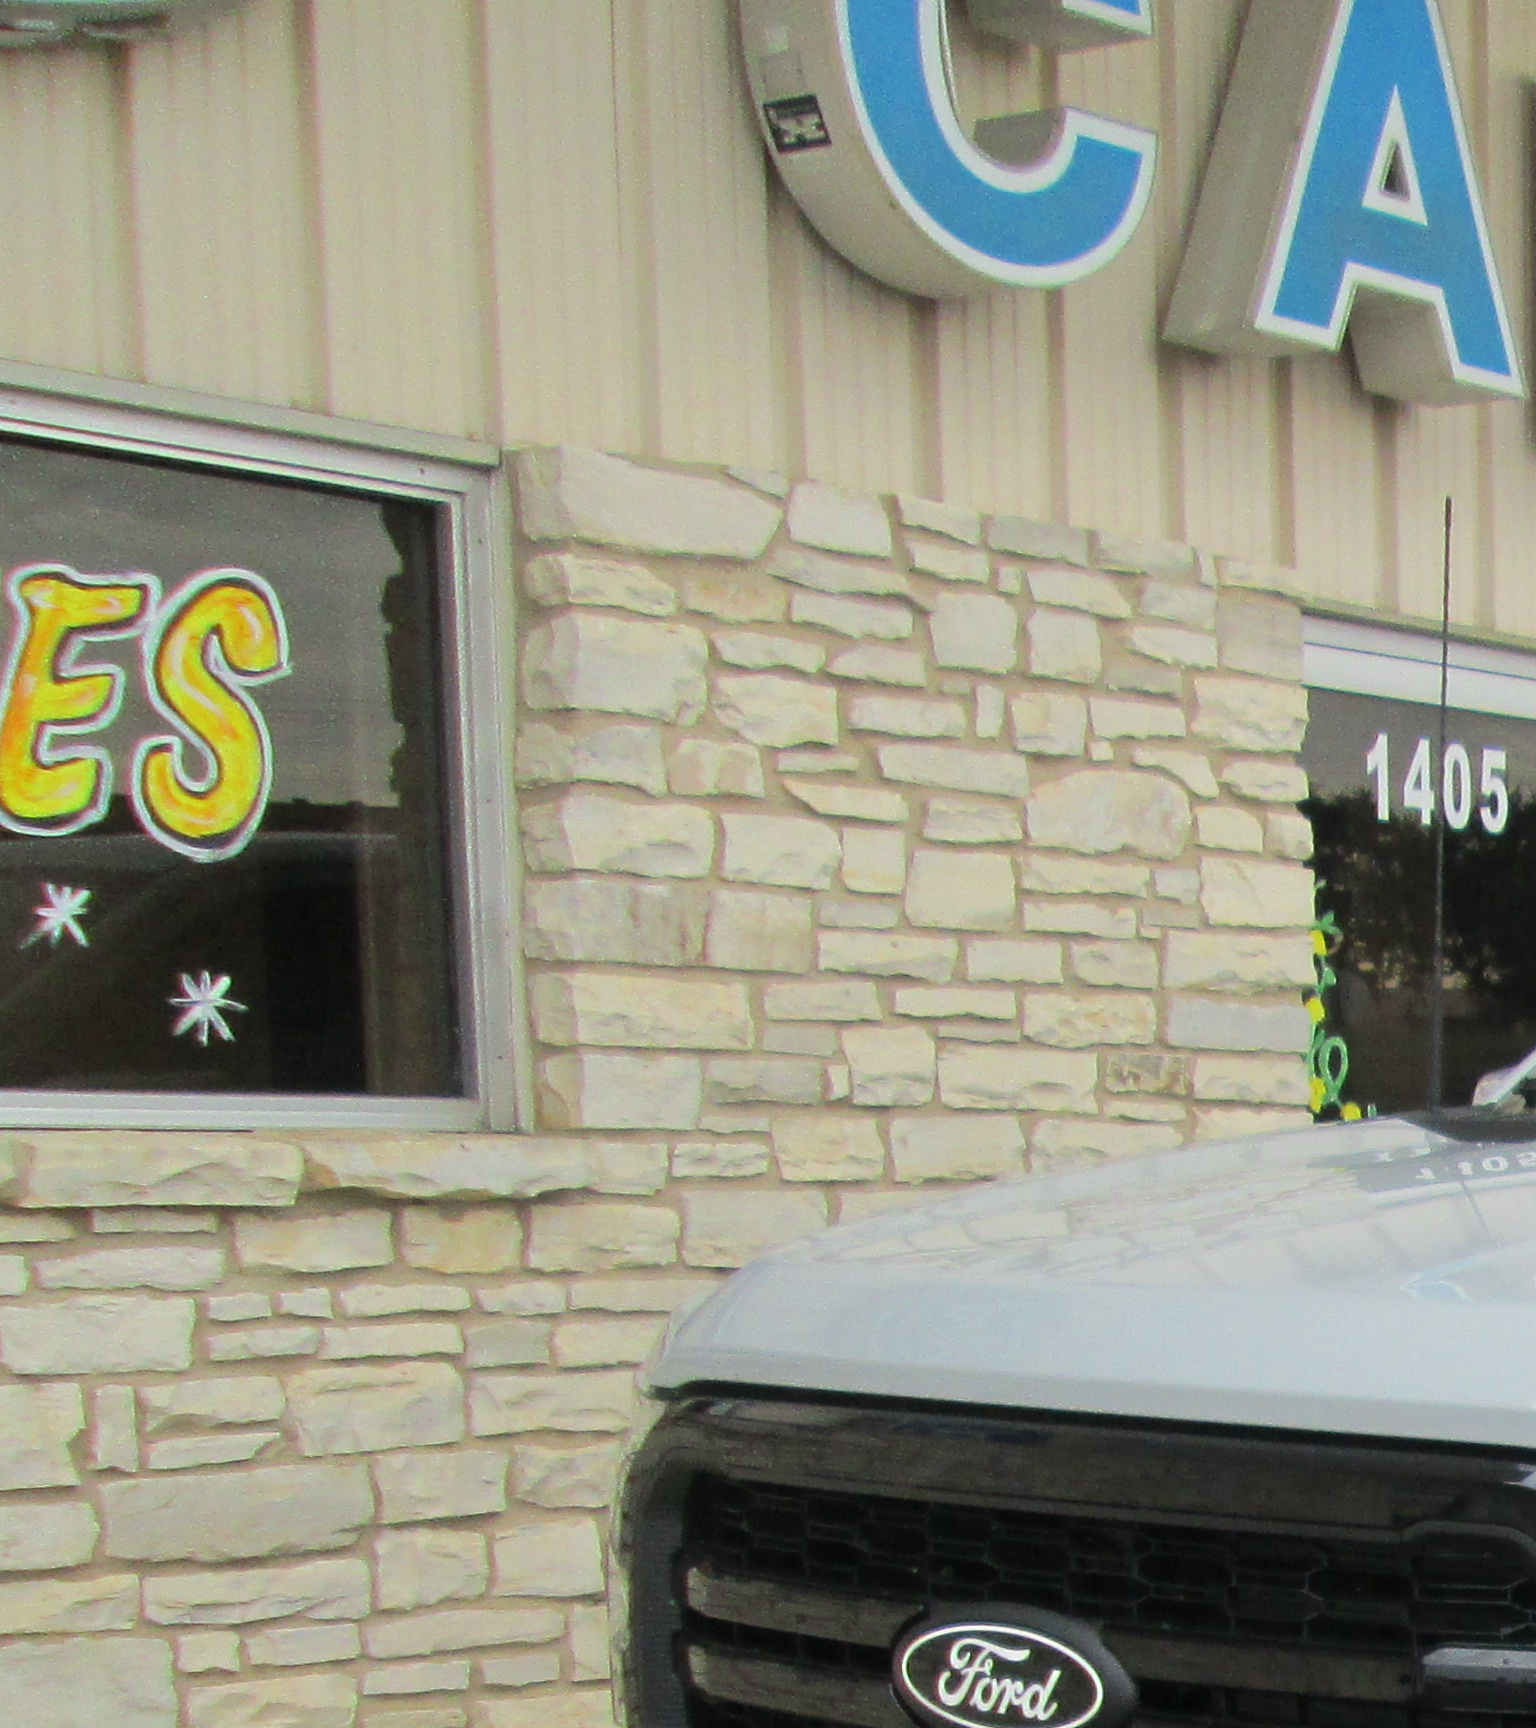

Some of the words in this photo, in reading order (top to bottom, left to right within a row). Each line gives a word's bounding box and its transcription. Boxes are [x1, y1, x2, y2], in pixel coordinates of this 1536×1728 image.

[0, 564, 290, 862] ES
[1366, 733, 1508, 834] 1405
[937, 1638, 1061, 1721] Ford
